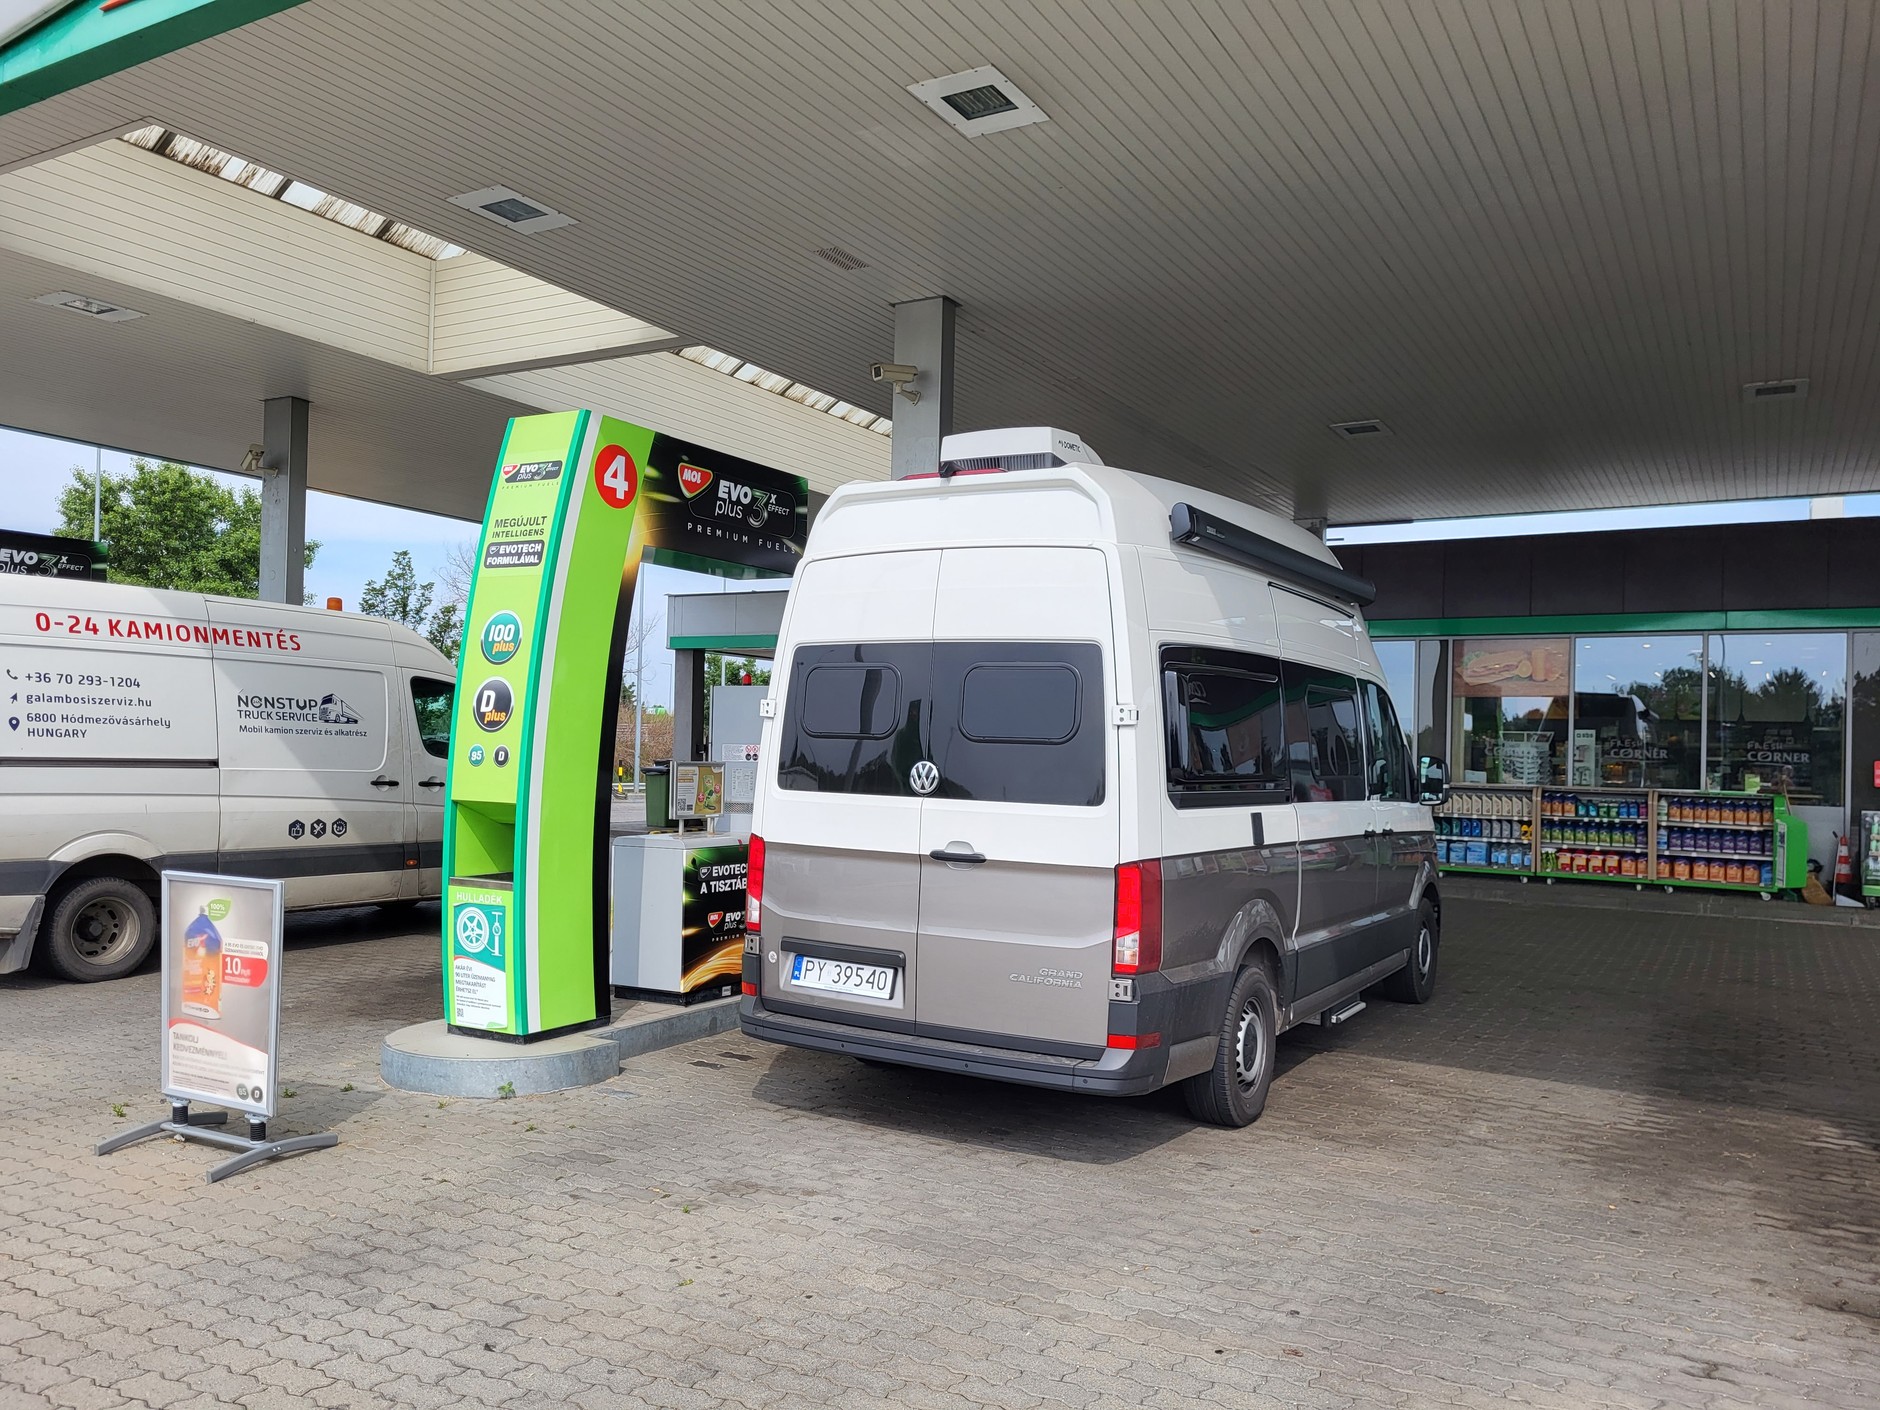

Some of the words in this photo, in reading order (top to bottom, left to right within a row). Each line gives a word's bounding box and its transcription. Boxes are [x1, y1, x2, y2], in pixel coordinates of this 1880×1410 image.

[519, 463, 539, 474] EVO
[516, 472, 532, 481] plus
[603, 454, 629, 500] 4
[682, 468, 702, 484] MOL
[717, 479, 753, 505] EVO
[714, 498, 744, 519] plus
[767, 503, 790, 516] EFFECT
[493, 515, 548, 529] MEGÚJULT
[491, 528, 545, 539] INTELLIGENS
[687, 522, 748, 543] PREMIUM
[758, 538, 796, 554] FUELS
[499, 542, 542, 554] EVOTECH
[0, 547, 39, 565] EVO
[486, 553, 540, 566] FORMULÁVAL
[57, 563, 84, 572] EFFECT
[35, 612, 100, 635] 0-24
[107, 618, 302, 652] KAMIONMENTÉS
[488, 623, 516, 642] 100
[491, 640, 515, 655] plus
[25, 671, 51, 684] +36
[56, 673, 73, 685] 70
[78, 674, 141, 688] 293-1204
[26, 692, 152, 707] galambosiszerviz.hu
[479, 689, 497, 713] D
[26, 712, 57, 723] 6800
[61, 713, 171, 729] Hódmezővásárhely
[237, 709, 273, 721] TRUCK
[275, 711, 318, 723] SERVICE
[483, 709, 506, 724] plus
[27, 727, 88, 739] HUNGARY
[239, 724, 263, 733] Mobil
[264, 725, 294, 735] kamion
[295, 727, 323, 736] szerviz
[324, 727, 333, 736] és
[334, 727, 368, 737] alkatrész
[471, 750, 482, 761] 95
[498, 751, 505, 761] D
[1609, 748, 1670, 760] CORNER
[1747, 751, 1811, 763] CORNER
[700, 882, 708, 895] A
[456, 891, 503, 904] HULLADÉK
[725, 911, 741, 922] EVO
[723, 921, 737, 931] plus
[224, 956, 242, 975] 10
[803, 960, 827, 982] PY
[832, 964, 888, 991] 39540
[1039, 967, 1083, 979] GRAND
[1009, 973, 1083, 989] CALIFORNIA
